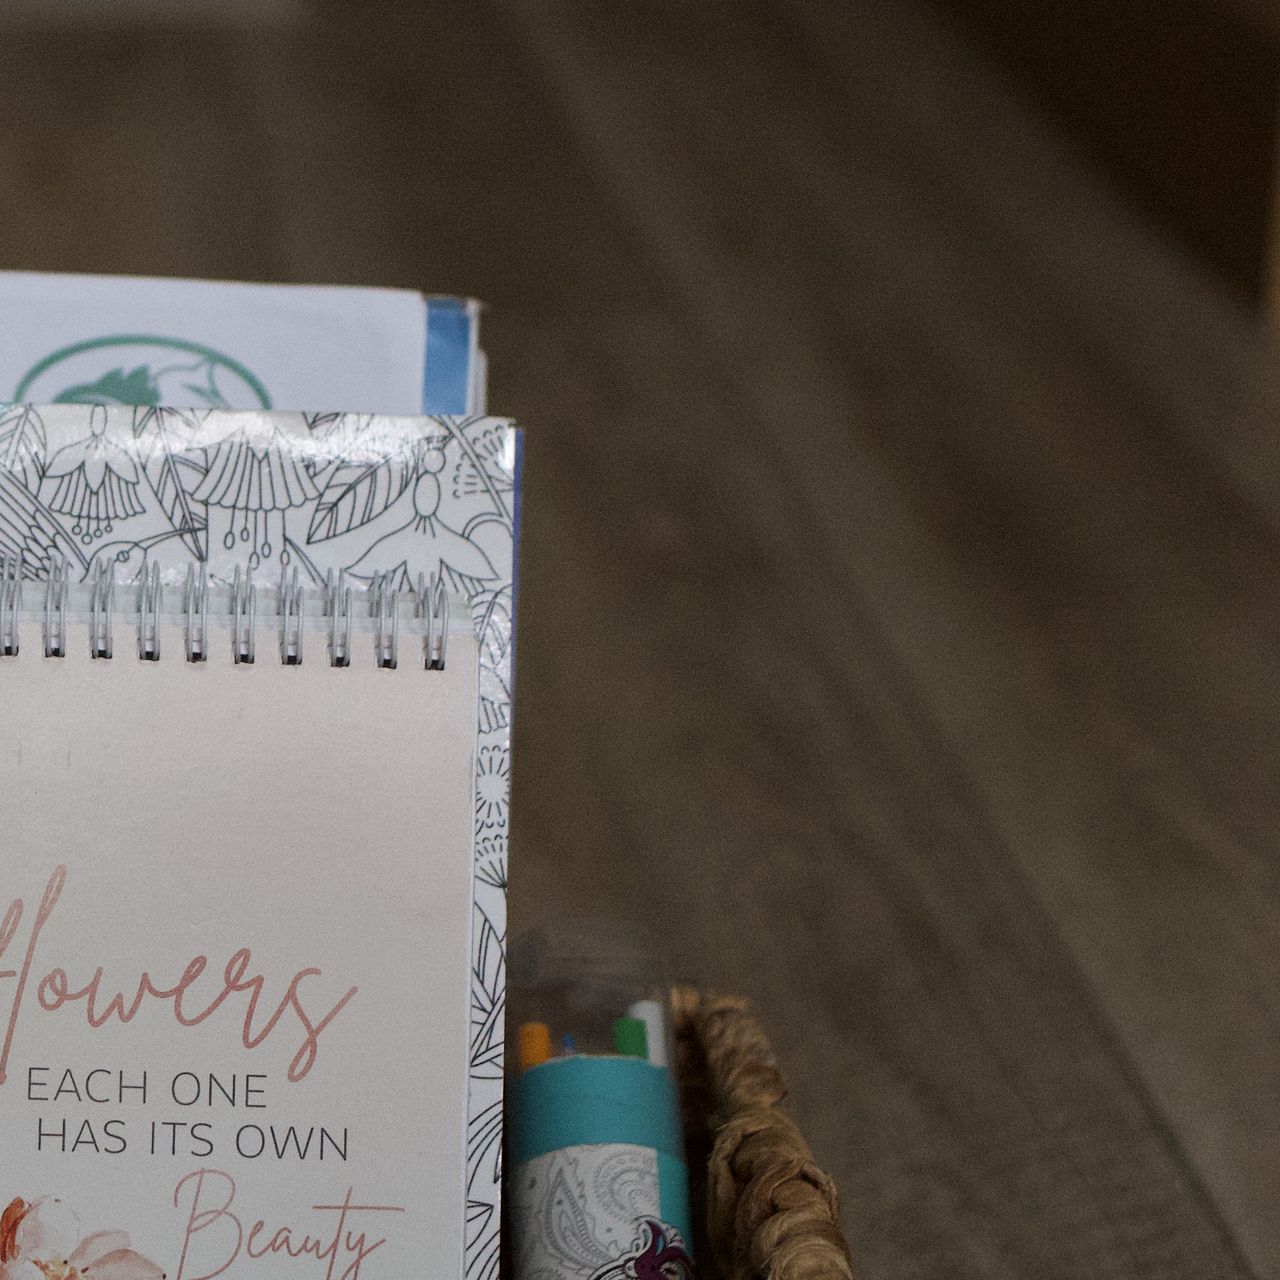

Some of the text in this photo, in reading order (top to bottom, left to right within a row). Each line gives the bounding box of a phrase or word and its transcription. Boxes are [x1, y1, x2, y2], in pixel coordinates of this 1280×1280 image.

[26, 1066, 269, 1110] EACH ONE
[36, 1118, 349, 1163] HAS ITS OWN
